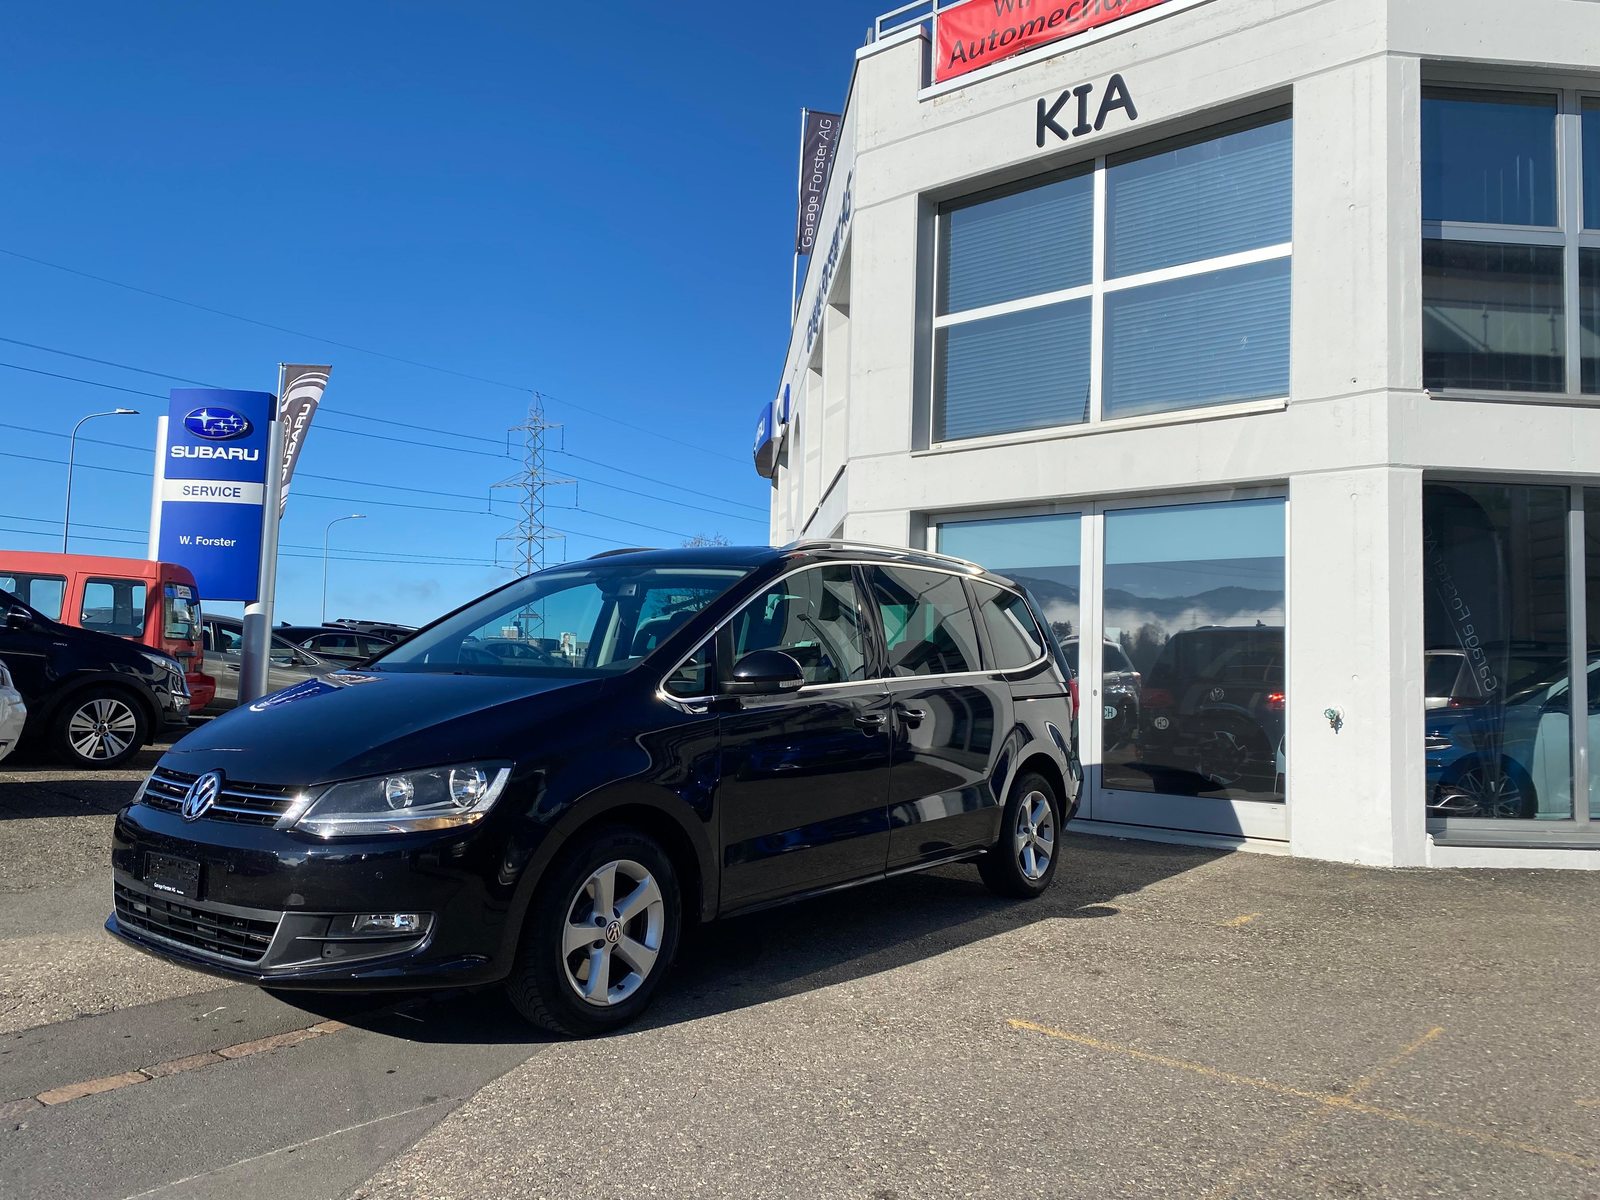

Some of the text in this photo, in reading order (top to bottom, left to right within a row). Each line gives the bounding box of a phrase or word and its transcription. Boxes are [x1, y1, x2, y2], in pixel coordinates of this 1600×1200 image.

[1036, 73, 1138, 148] KIA
[802, 118, 832, 248] Garage Forster AG
[170, 445, 259, 461] SUBARU
[182, 485, 242, 498] SERVICE
[179, 535, 236, 547] W. Forster
